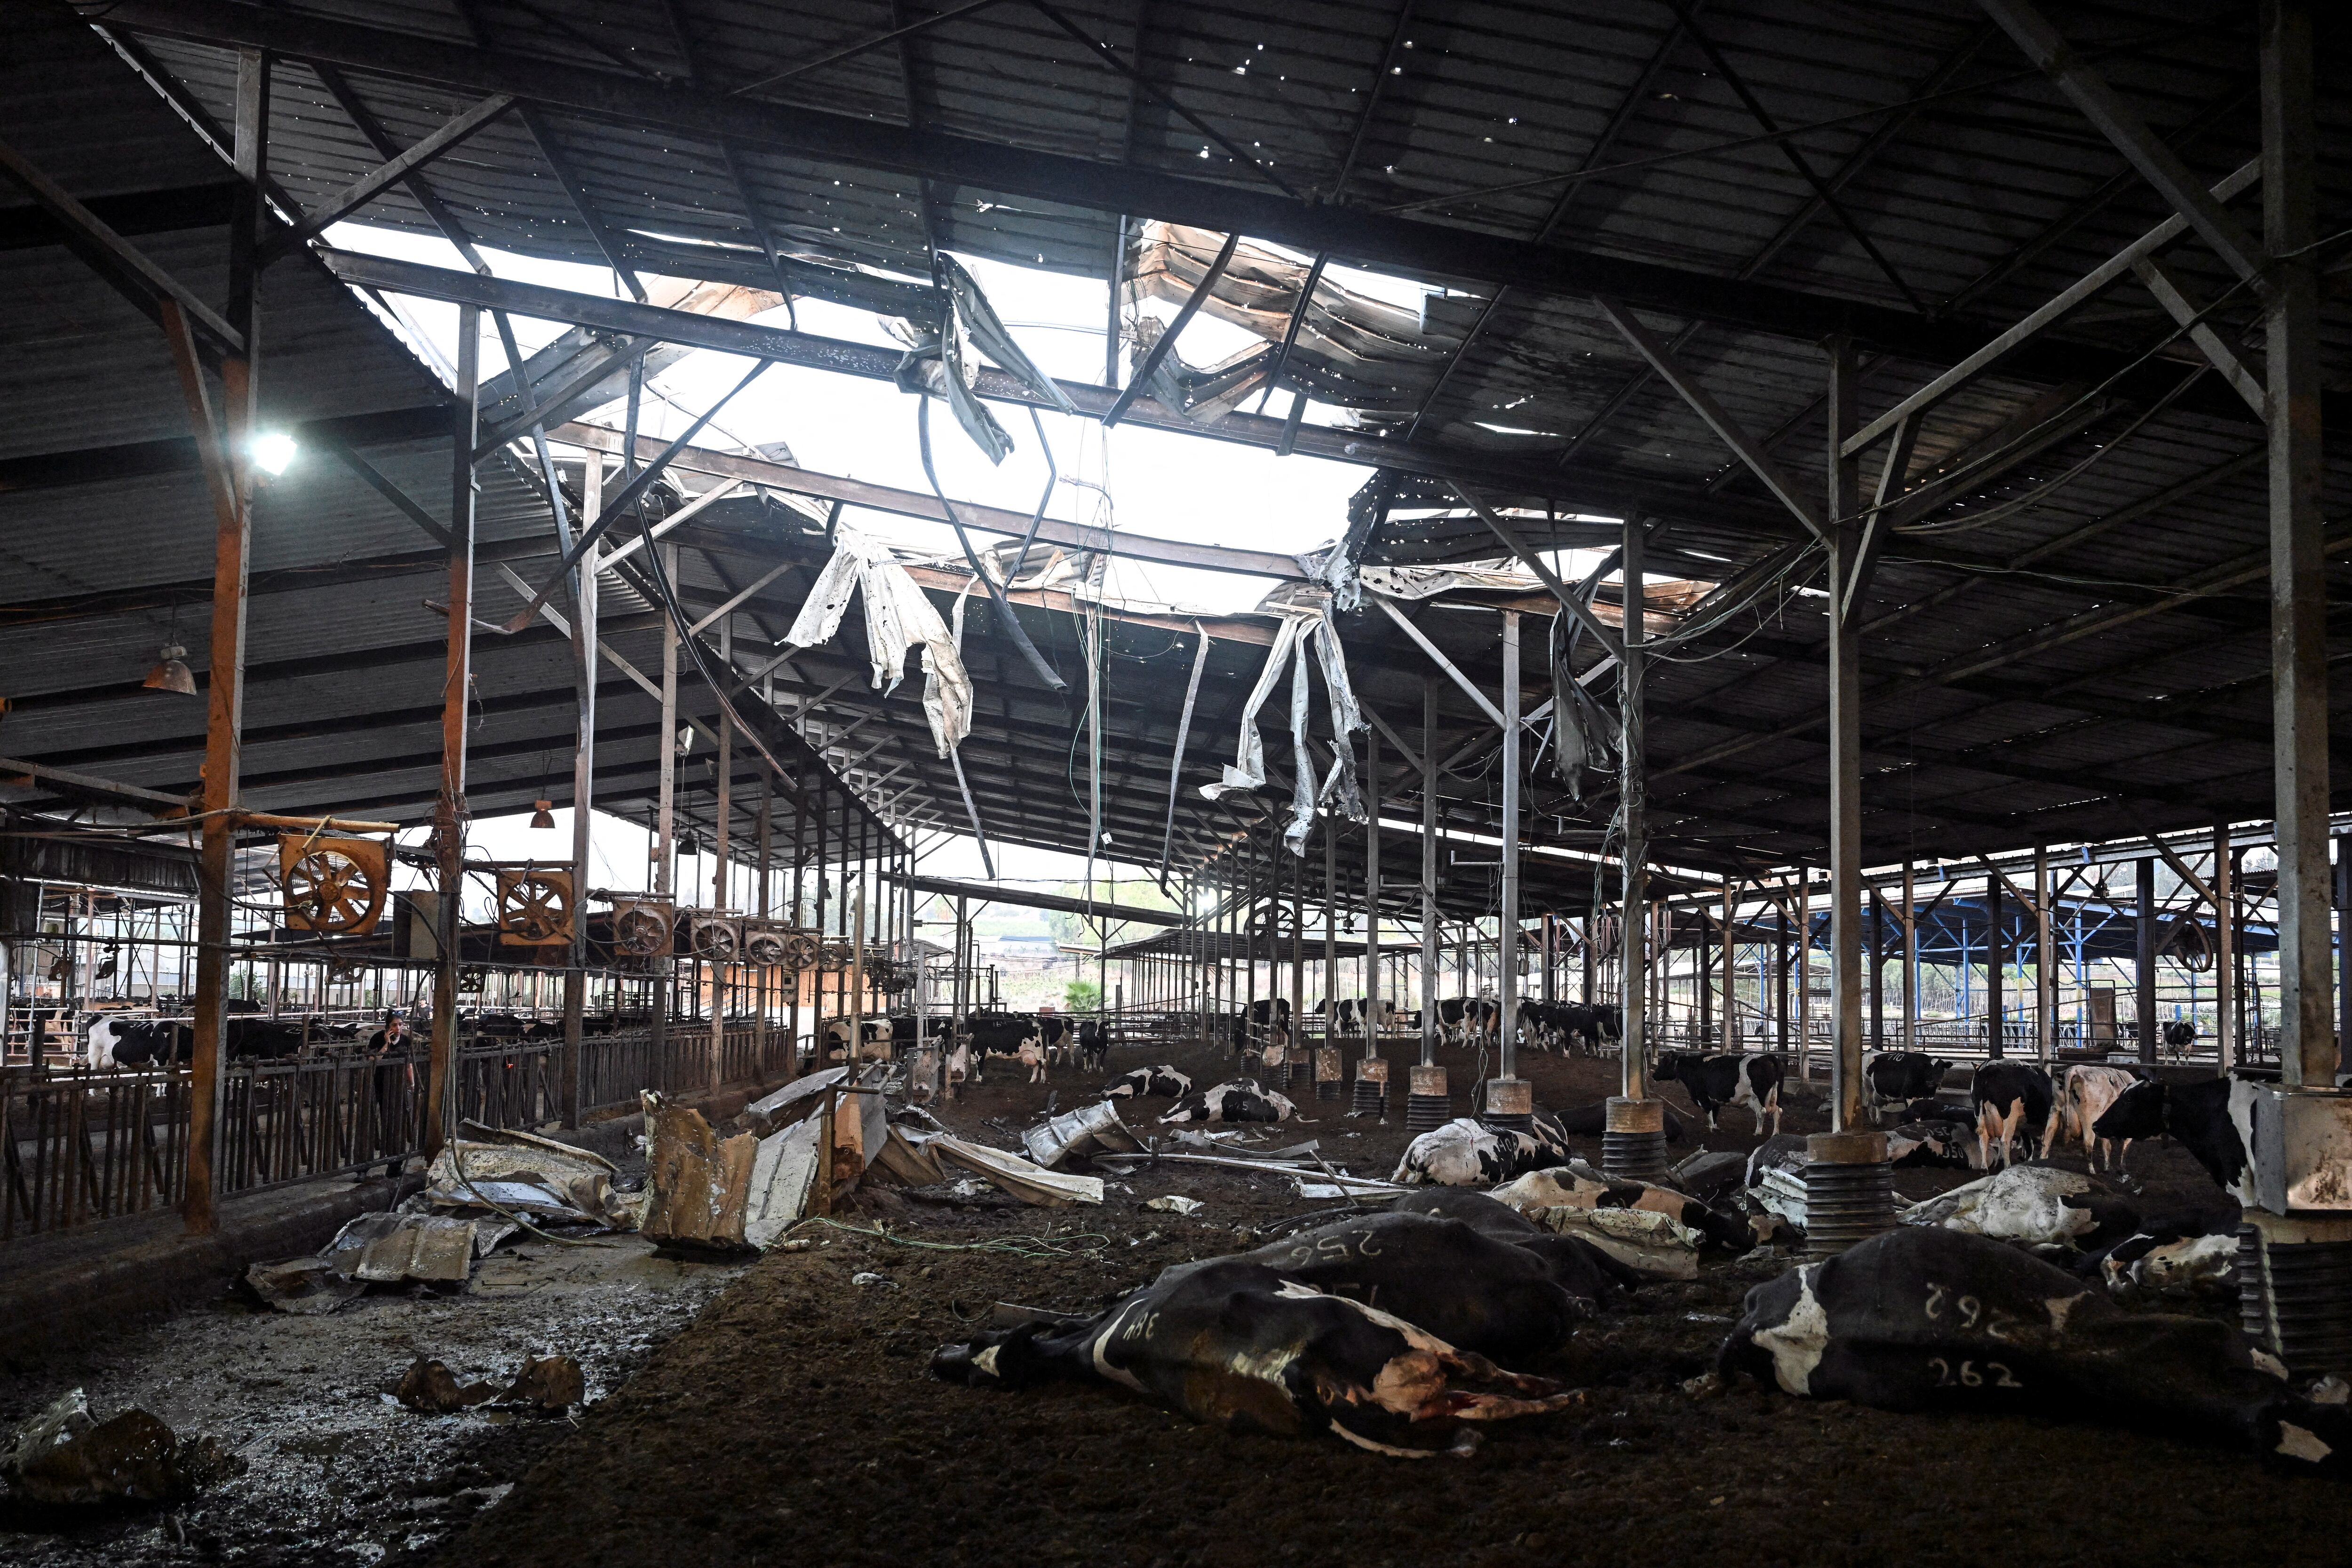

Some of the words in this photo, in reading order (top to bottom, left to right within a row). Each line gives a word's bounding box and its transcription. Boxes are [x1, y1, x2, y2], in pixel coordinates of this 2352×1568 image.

[1888, 1053, 1905, 1062] 710
[1290, 1229, 1383, 1266] 256
[1928, 1356, 2024, 1388] 262
